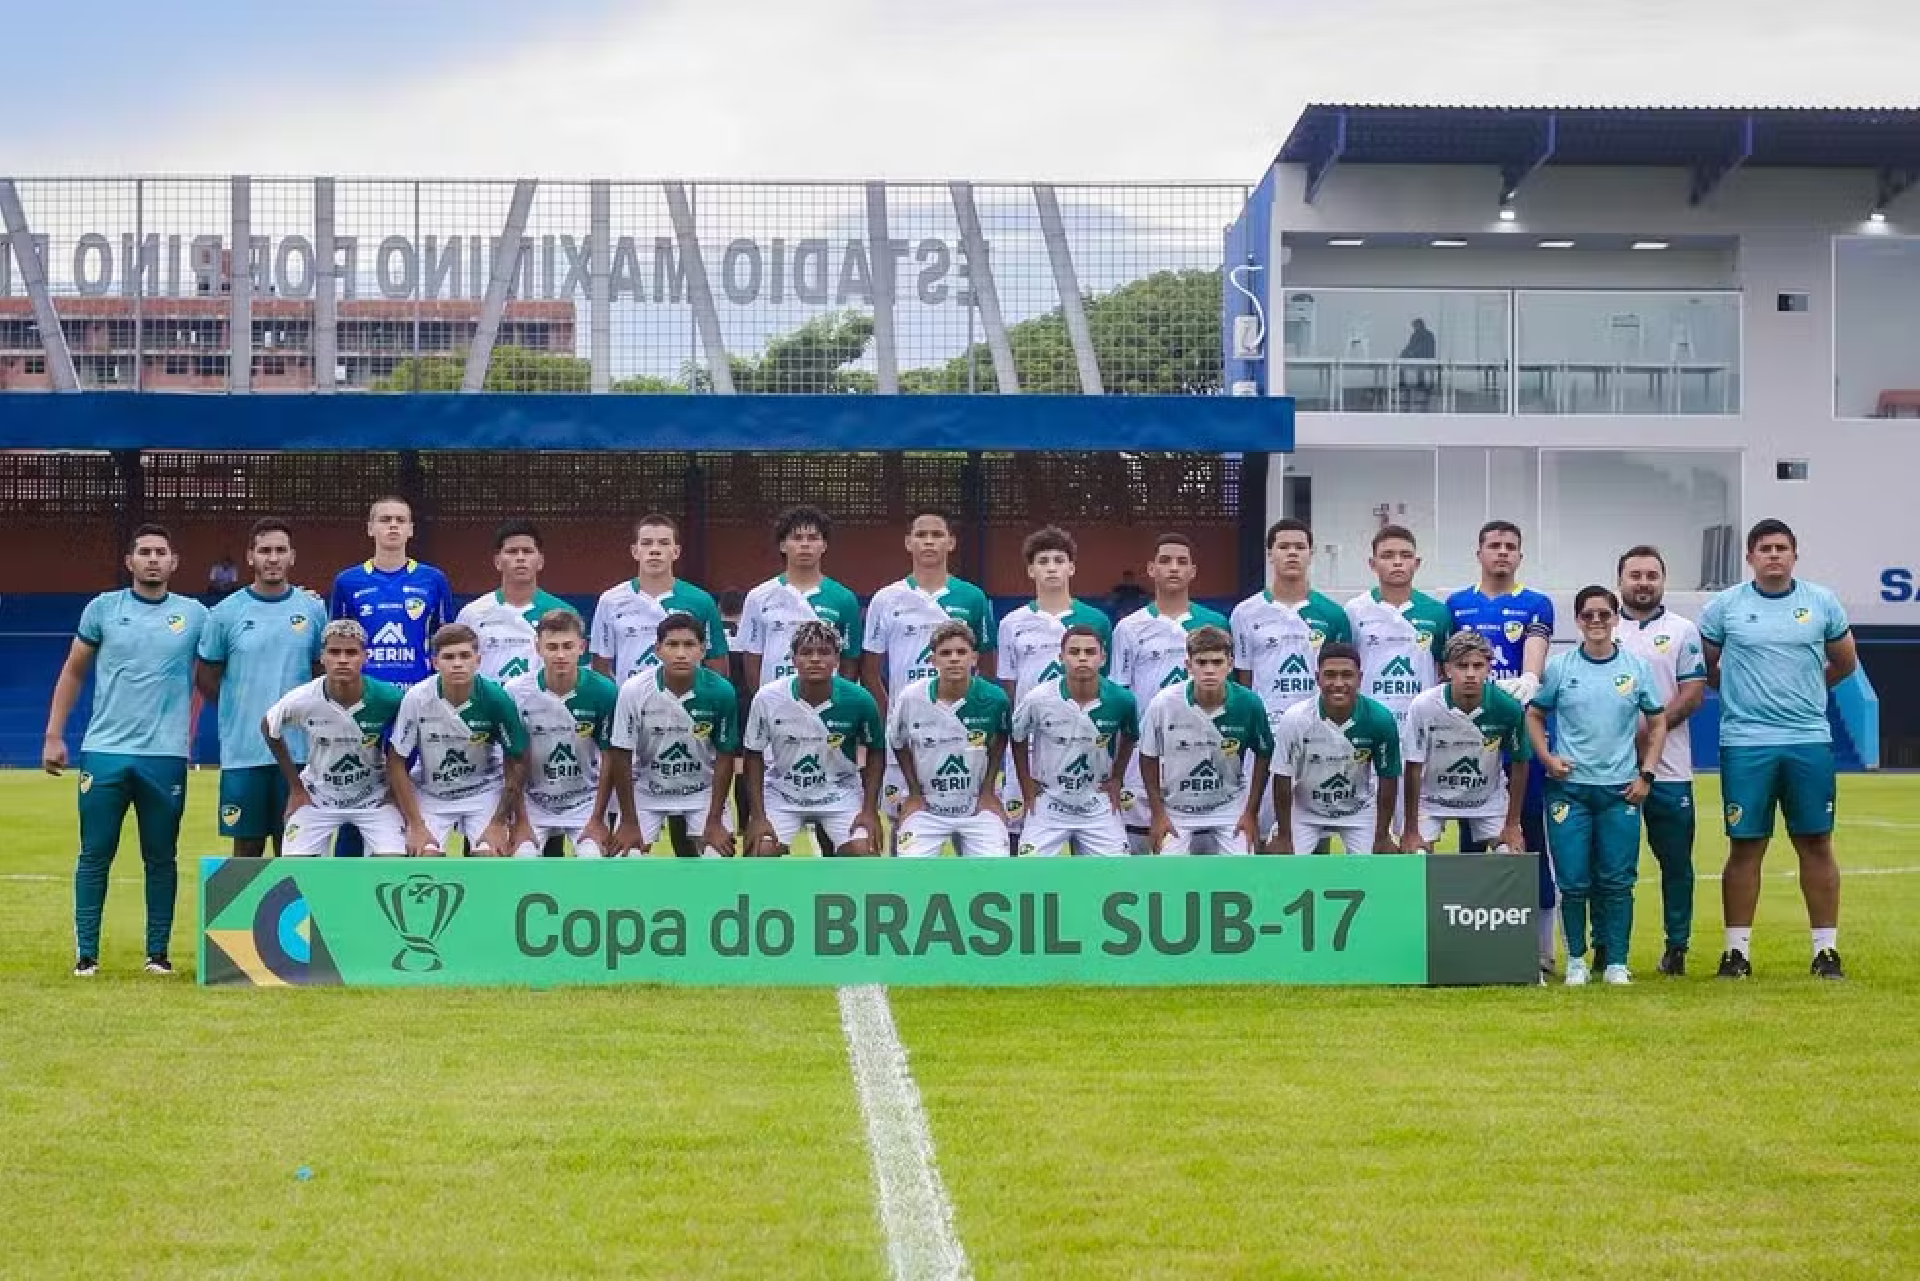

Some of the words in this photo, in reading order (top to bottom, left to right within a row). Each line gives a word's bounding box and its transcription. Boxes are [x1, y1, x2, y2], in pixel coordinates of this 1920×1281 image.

[1880, 567, 1920, 603] S
[1372, 680, 1422, 694] PERIN
[323, 767, 371, 786] PERIN
[650, 761, 701, 777] PERIN
[1437, 775, 1488, 789] PERIN
[1443, 903, 1531, 931] Topper
[514, 893, 686, 970] Copa
[710, 894, 794, 957] do
[815, 891, 1080, 956] BRASIL
[1101, 889, 1366, 955] SUB-17
